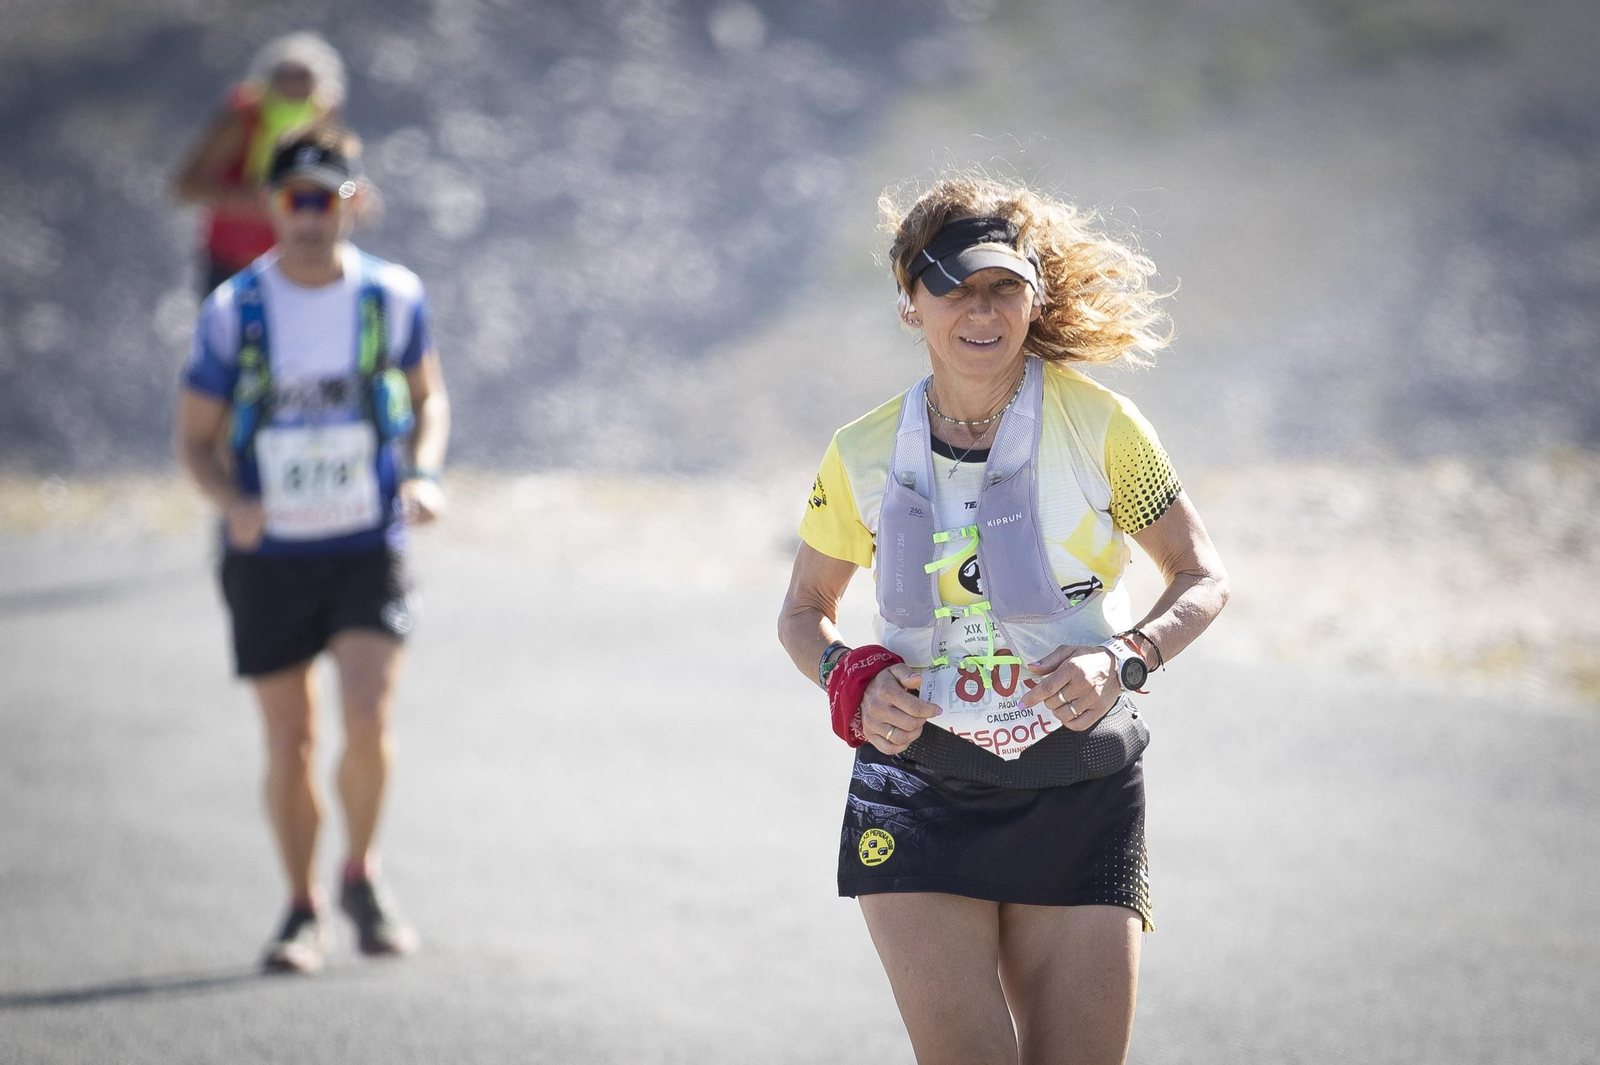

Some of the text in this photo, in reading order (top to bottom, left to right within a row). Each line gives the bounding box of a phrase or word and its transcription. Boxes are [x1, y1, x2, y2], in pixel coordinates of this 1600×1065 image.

[964, 501, 977, 510] TE
[986, 511, 1023, 528] KIPRUN
[896, 573, 904, 593] SOFT
[964, 623, 982, 635] XIX
[847, 653, 892, 677] PRIEGO
[987, 708, 1034, 724] CALDERON
